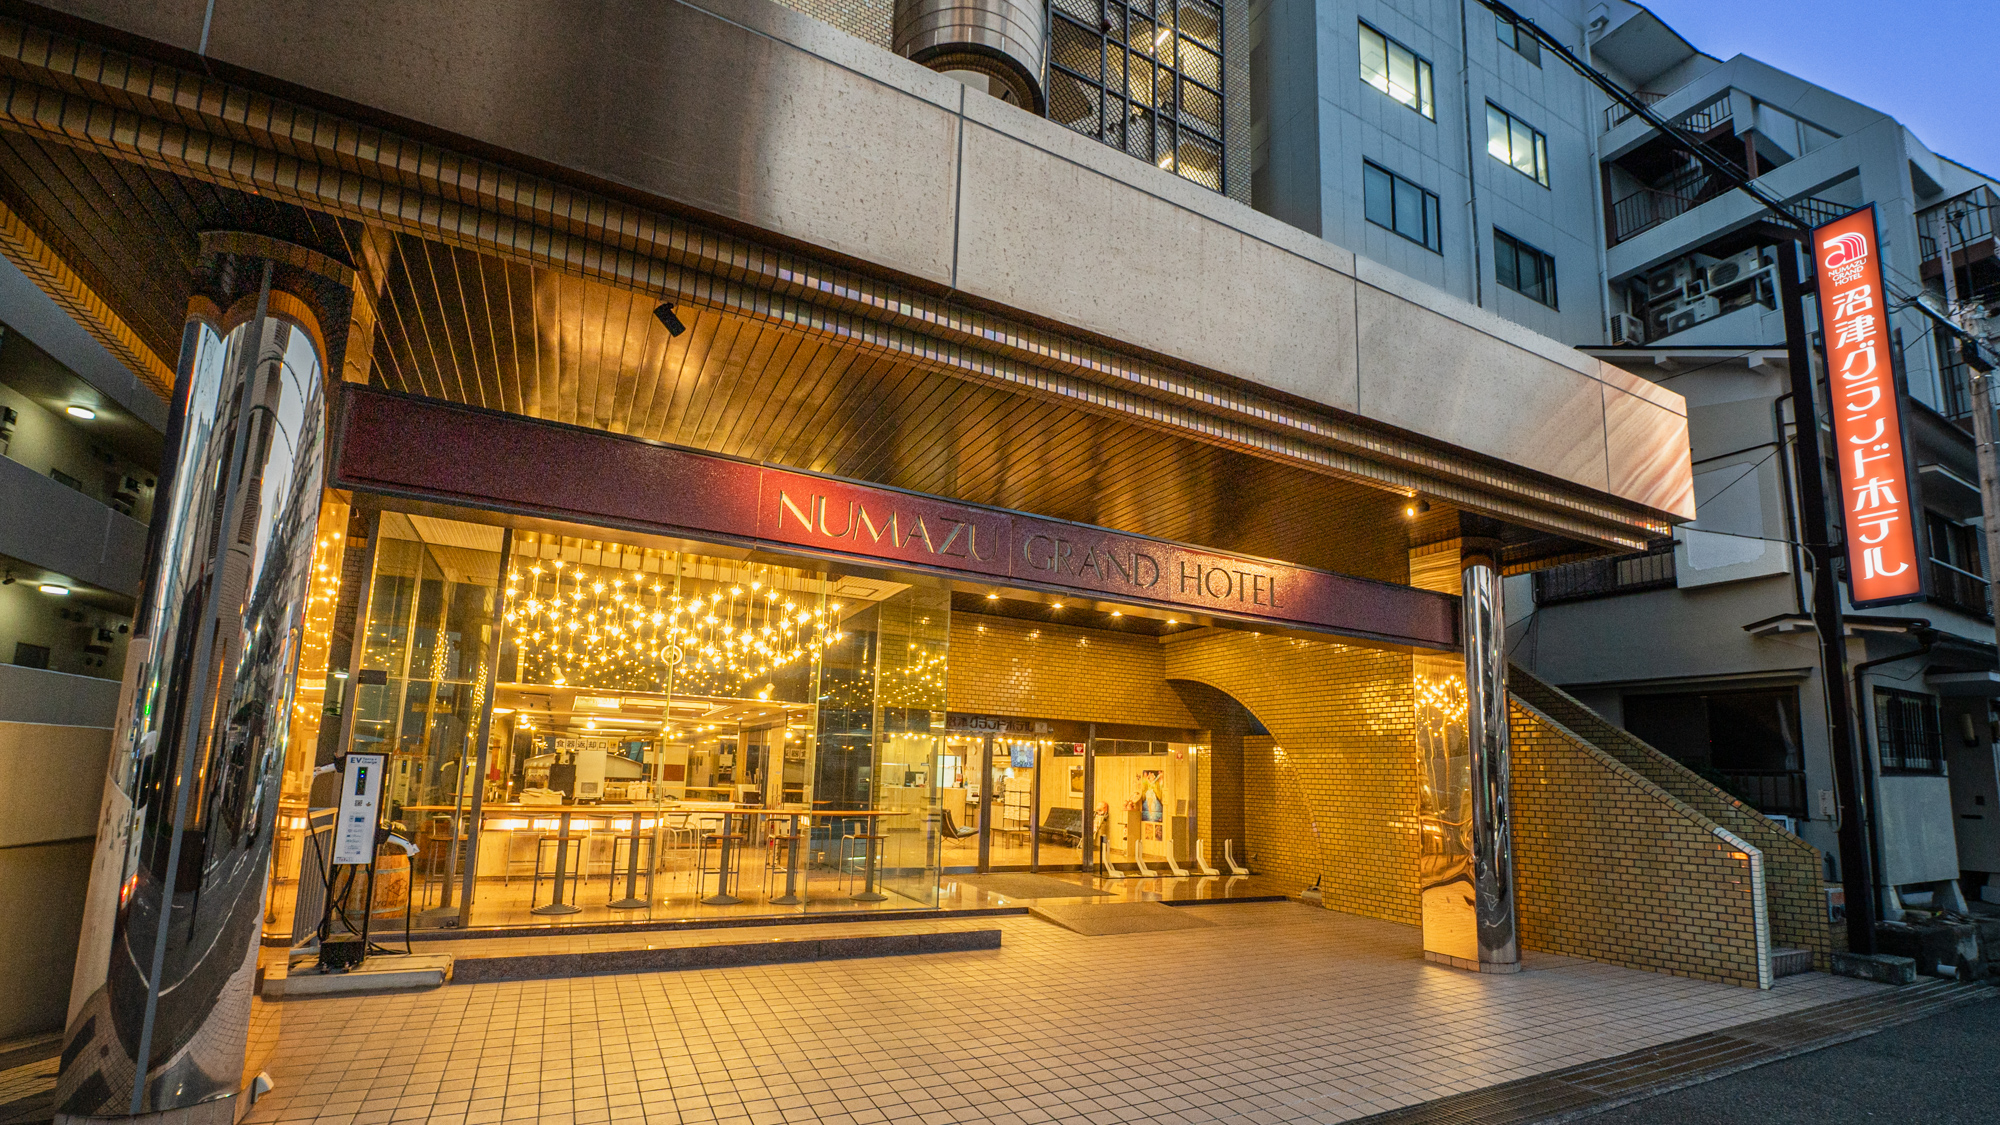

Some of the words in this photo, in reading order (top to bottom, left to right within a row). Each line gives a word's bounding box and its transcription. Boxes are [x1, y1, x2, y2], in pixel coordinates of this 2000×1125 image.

[1828, 258, 1867, 277] NUMAZU
[1832, 265, 1864, 281] GRAND
[1835, 272, 1862, 287] HOTEL
[1832, 284, 1909, 580] 沼津グランドホテル
[778, 490, 998, 561] NUMAZU
[1023, 535, 1160, 588] GRAND
[1180, 561, 1284, 608] HOTEL
[350, 756, 362, 764] EV
